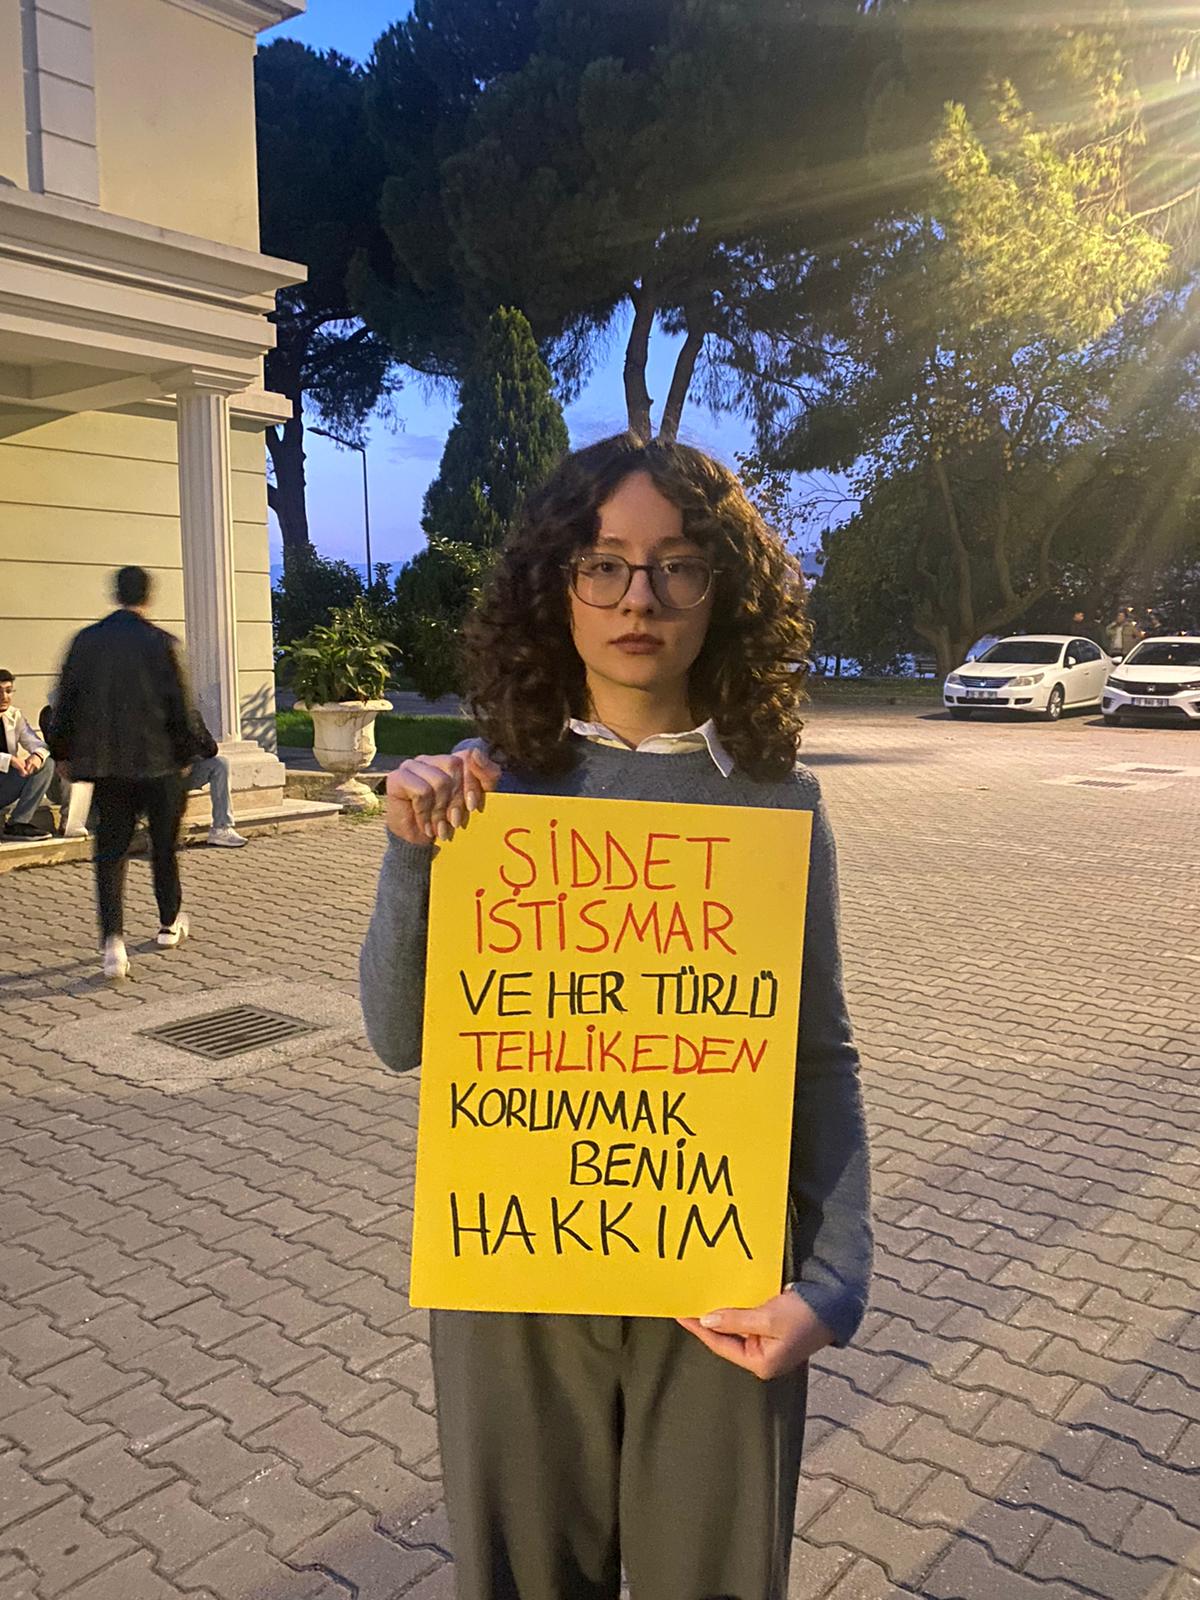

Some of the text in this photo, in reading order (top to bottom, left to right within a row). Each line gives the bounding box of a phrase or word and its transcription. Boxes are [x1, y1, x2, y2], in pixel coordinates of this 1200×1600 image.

[499, 818, 731, 894] ŞİDDET
[475, 888, 737, 955] İSTİSMAR
[459, 966, 778, 1019] VE HER TÜRLÜ
[460, 1024, 768, 1074] TEHLİKEDEN
[451, 1082, 697, 1136] KORUNMAK
[570, 1138, 734, 1196] BENİM
[450, 1193, 753, 1260] HAKKIM
